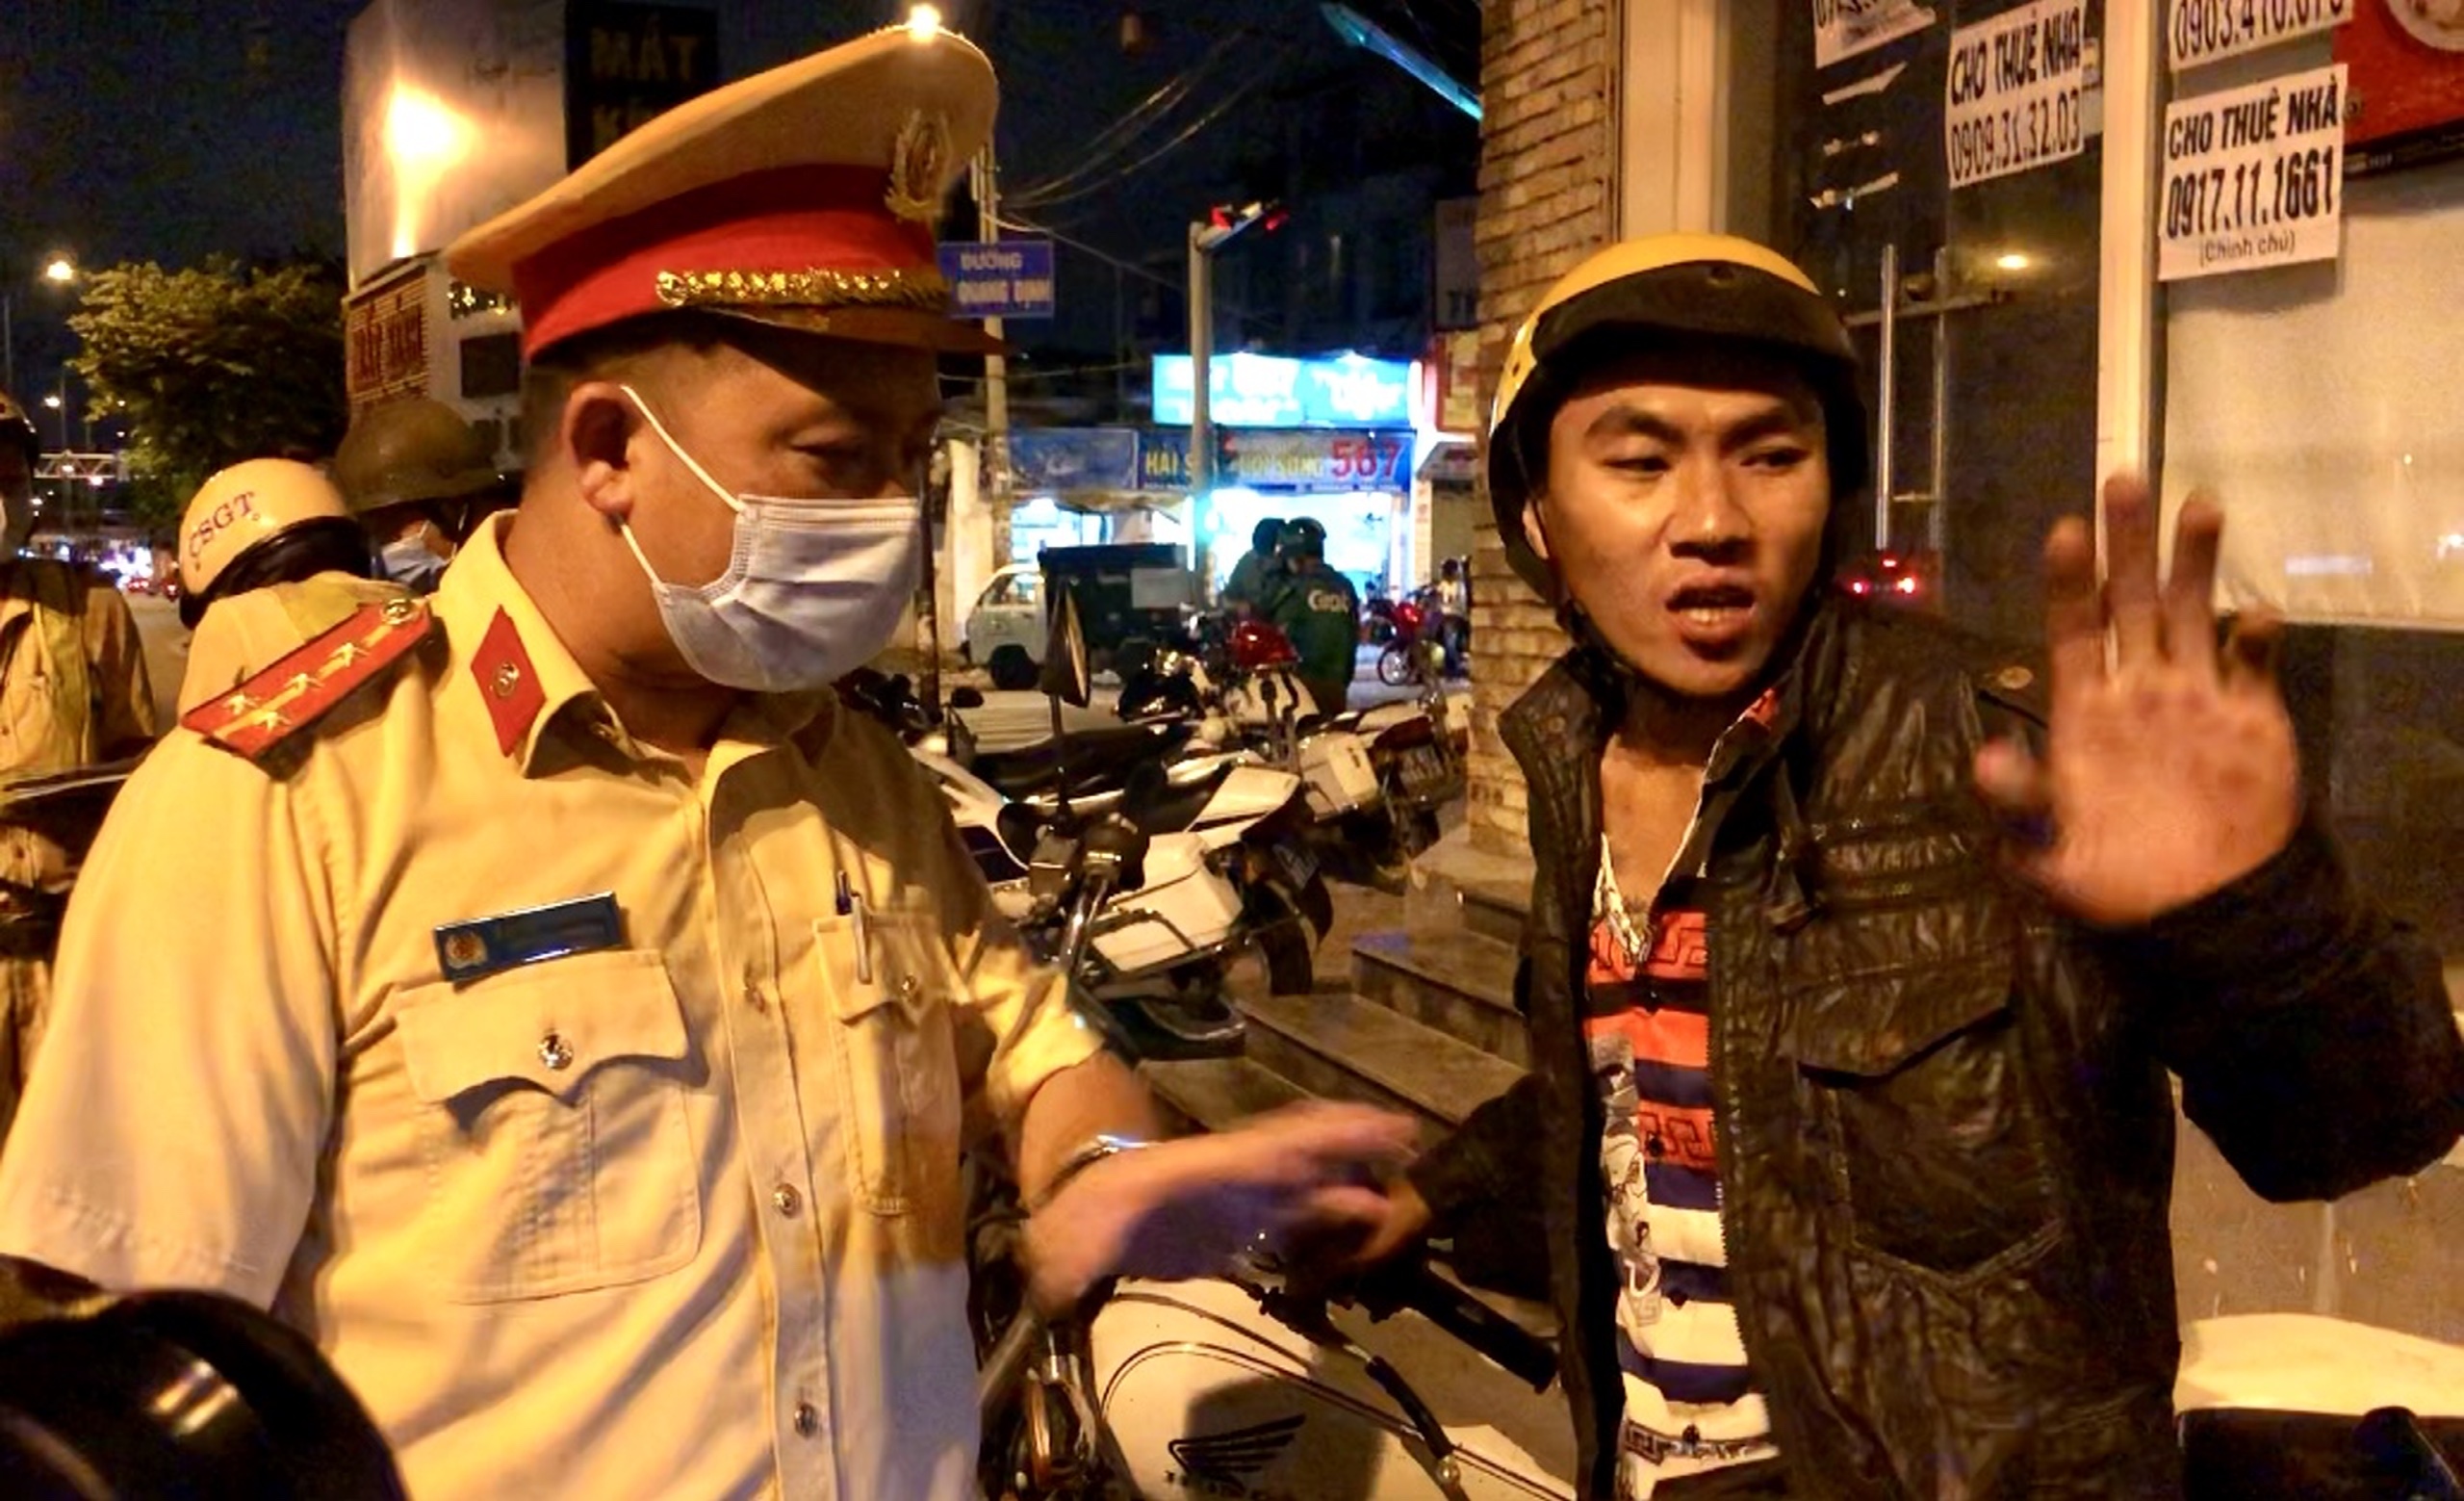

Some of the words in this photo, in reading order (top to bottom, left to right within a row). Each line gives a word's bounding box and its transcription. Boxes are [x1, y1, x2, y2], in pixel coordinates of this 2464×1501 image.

[2176, 0, 2343, 60] 0903.410.
[1951, 40, 1987, 106] CHO
[1951, 88, 2080, 181] 0909.31.32.03
[2169, 112, 2213, 160] CHO
[2221, 88, 2280, 149] THUÊ
[2286, 74, 2338, 136] NHÀ
[2167, 145, 2334, 239] 0917.11.1661
[1331, 439, 1402, 479] 567
[189, 491, 254, 557] CSGT
